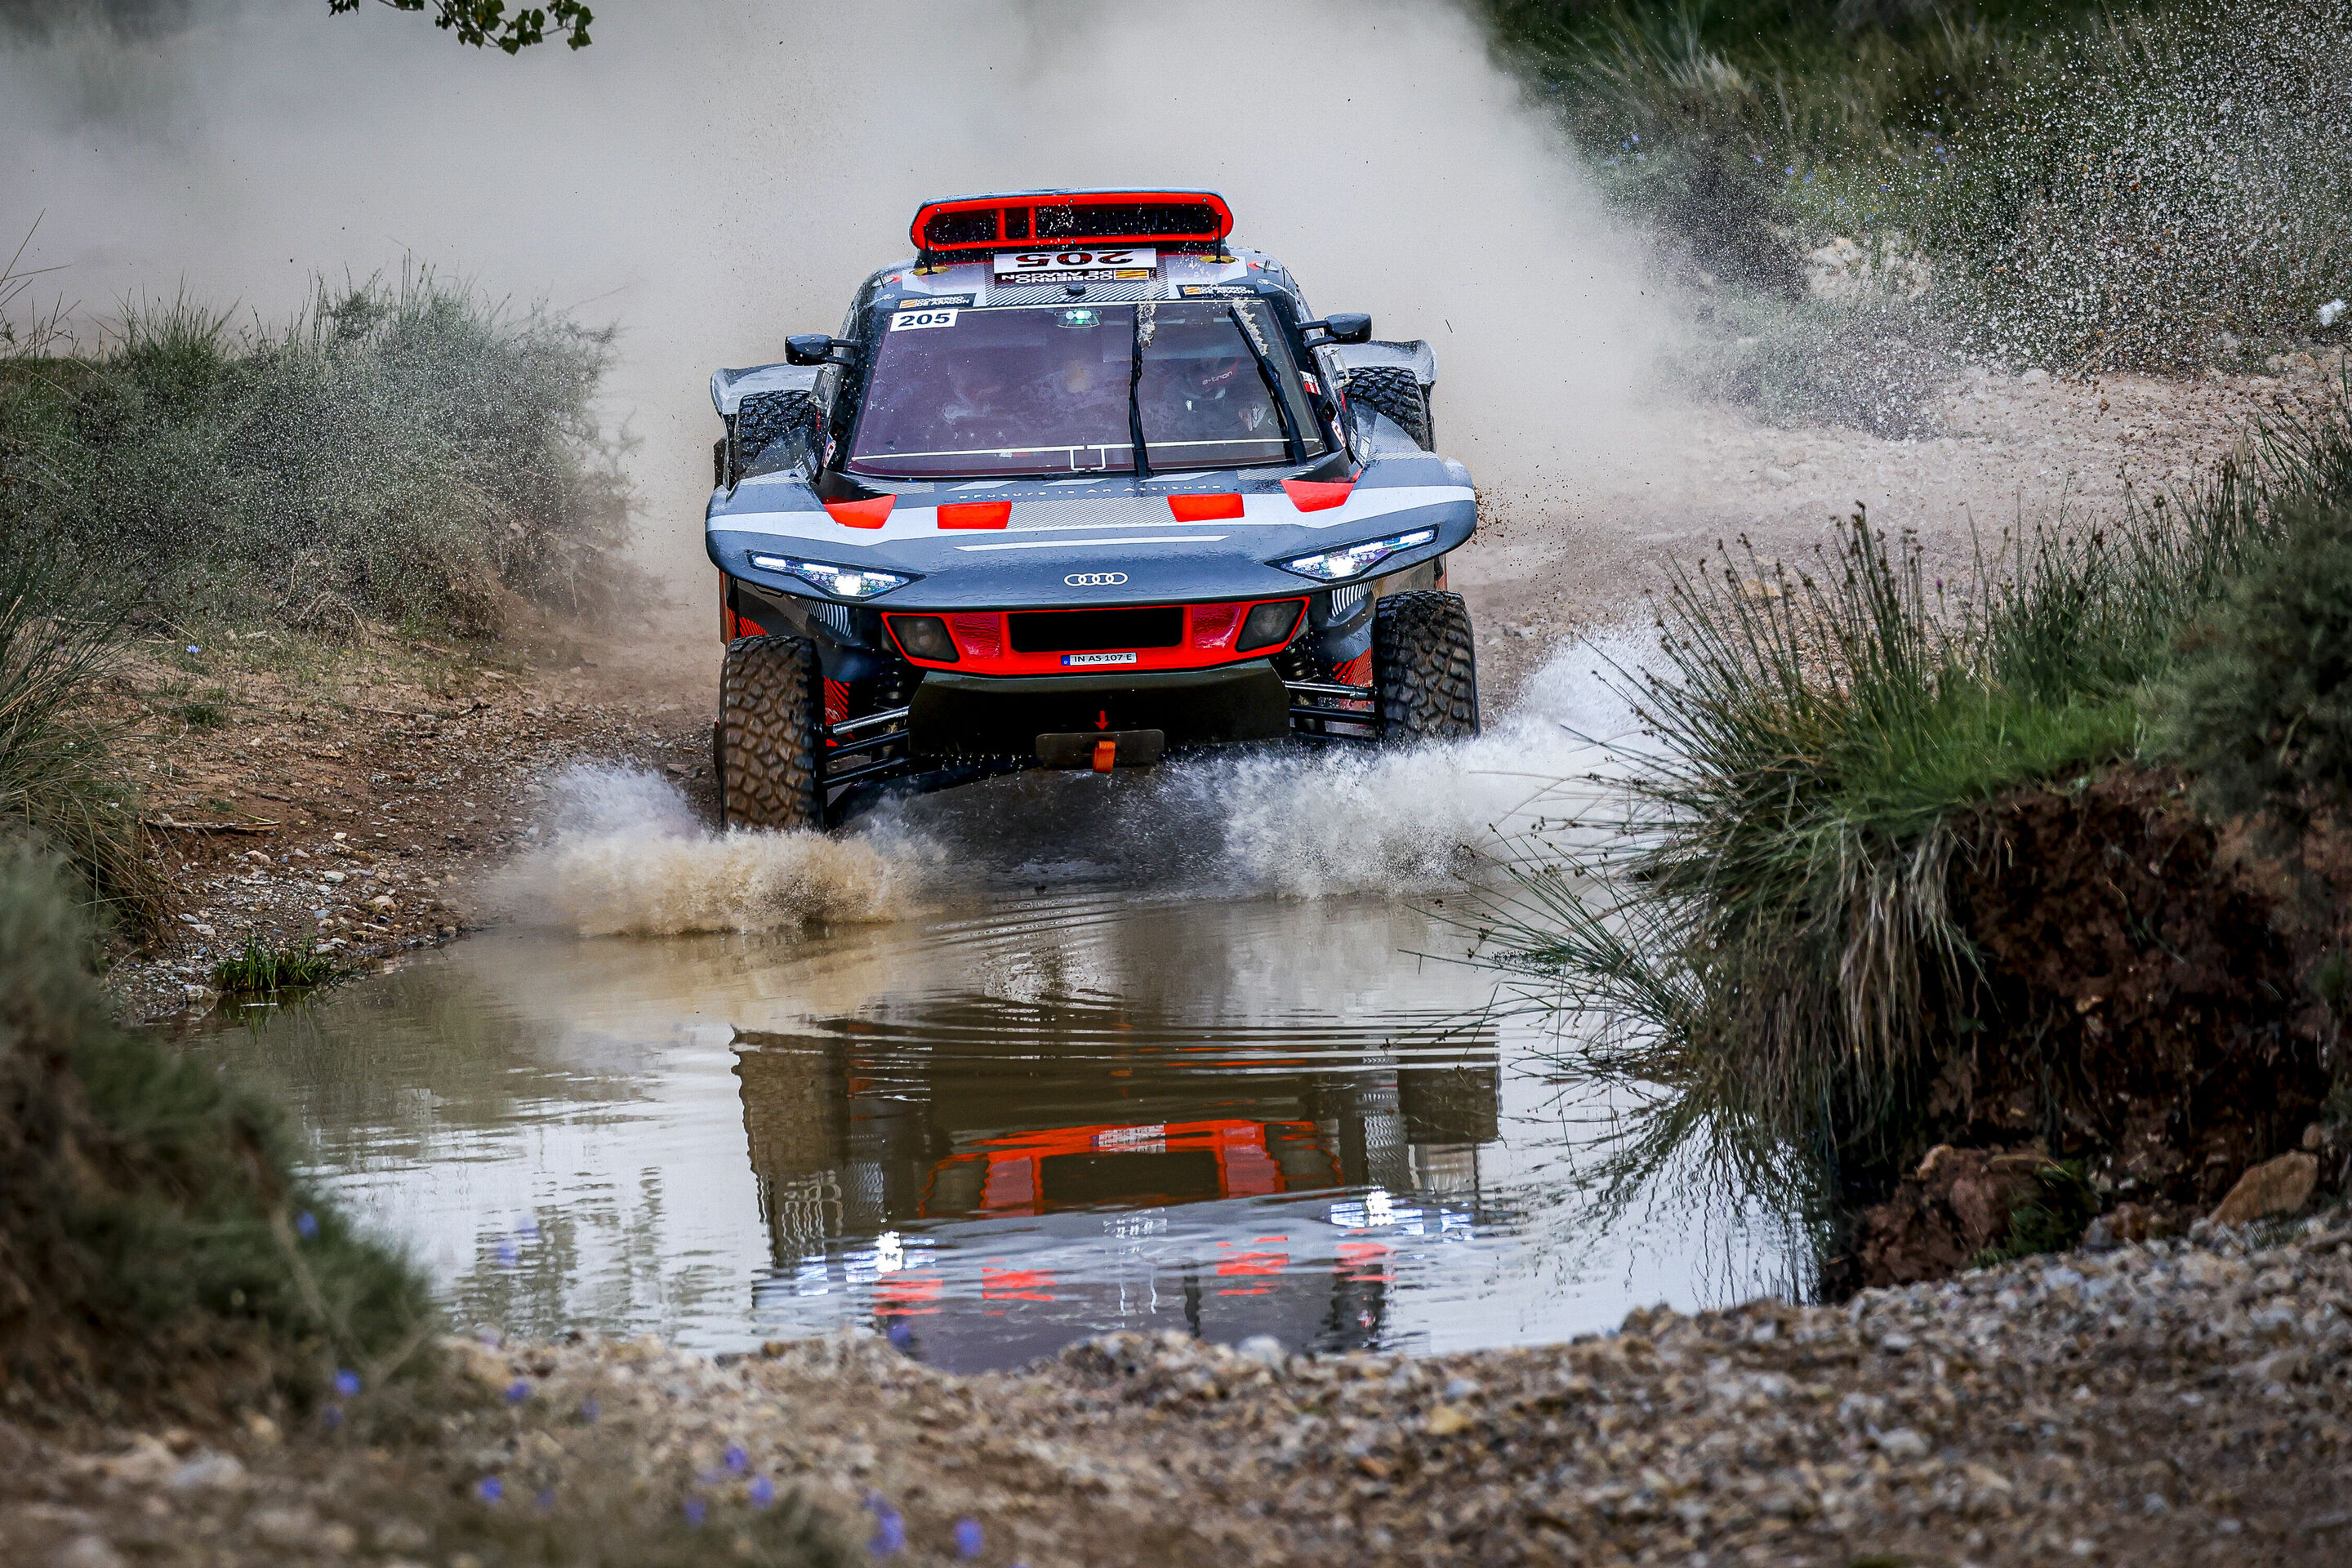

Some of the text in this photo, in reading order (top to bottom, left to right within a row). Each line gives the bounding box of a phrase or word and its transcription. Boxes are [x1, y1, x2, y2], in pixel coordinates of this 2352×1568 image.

[1015, 251, 1134, 268] 205
[1001, 271, 1080, 280] ARAGON
[1015, 275, 1114, 284] GOBIERNO
[898, 313, 951, 327] 205
